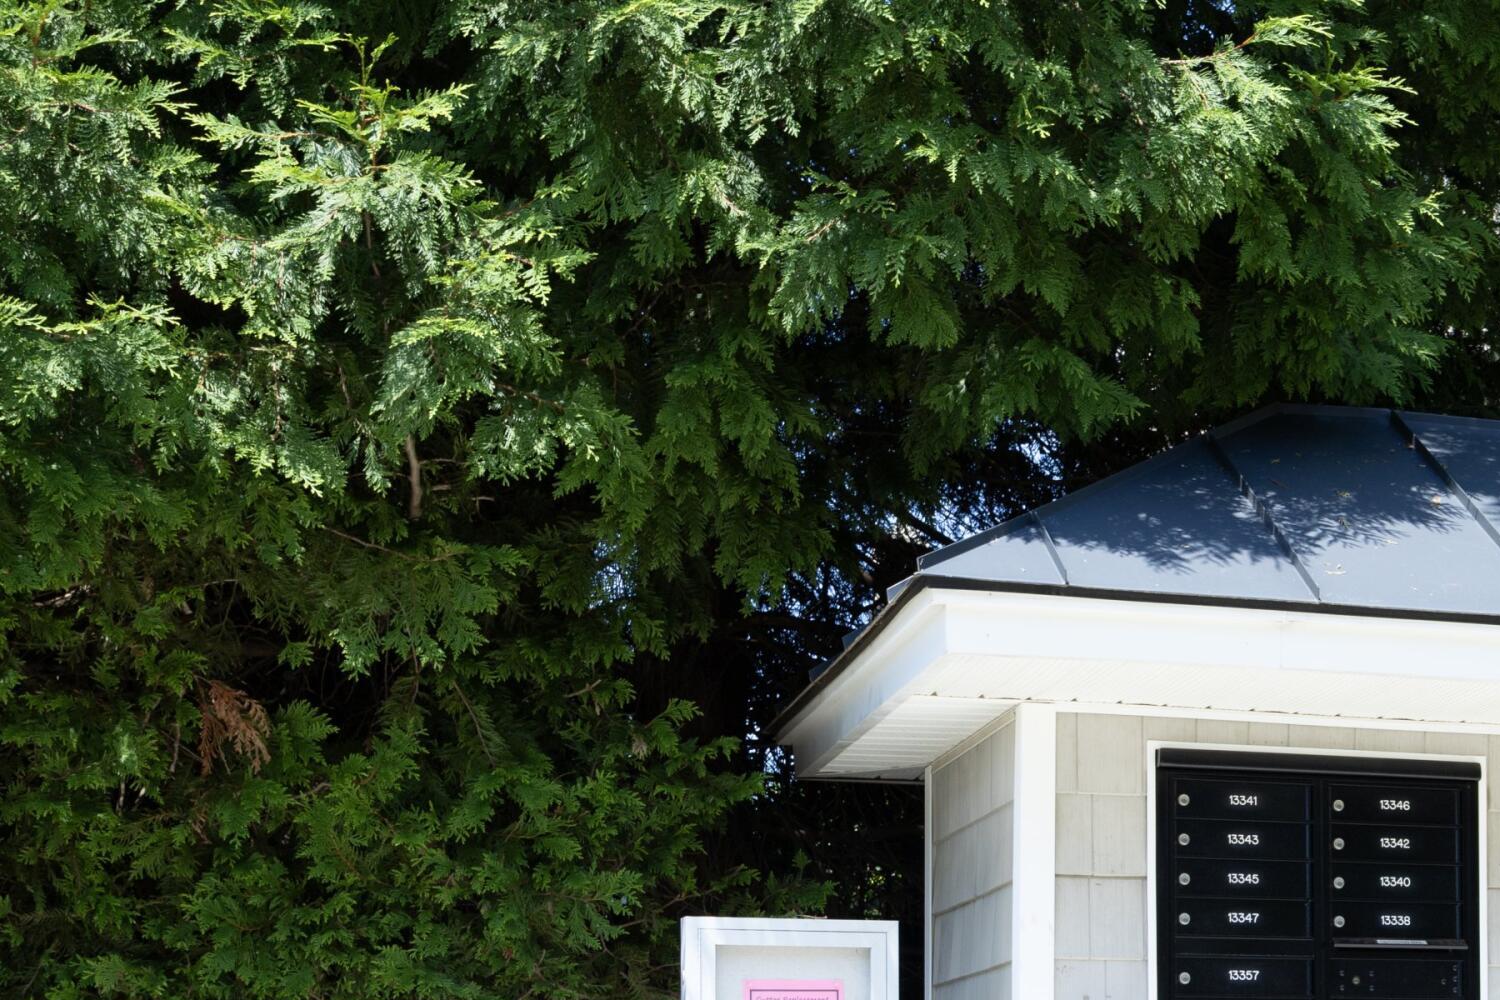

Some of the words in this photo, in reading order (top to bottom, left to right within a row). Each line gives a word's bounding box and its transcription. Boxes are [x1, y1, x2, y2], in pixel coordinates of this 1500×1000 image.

[1228, 794, 1258, 806] 13341
[1379, 799, 1411, 811] 13346
[1227, 833, 1260, 846] 13343
[1379, 837, 1411, 849] 13342
[1227, 872, 1260, 885] 13345
[1379, 876, 1412, 888] 13340
[1227, 912, 1260, 924] 13347
[1380, 914, 1411, 926] 13338
[1228, 969, 1260, 981] 13357
